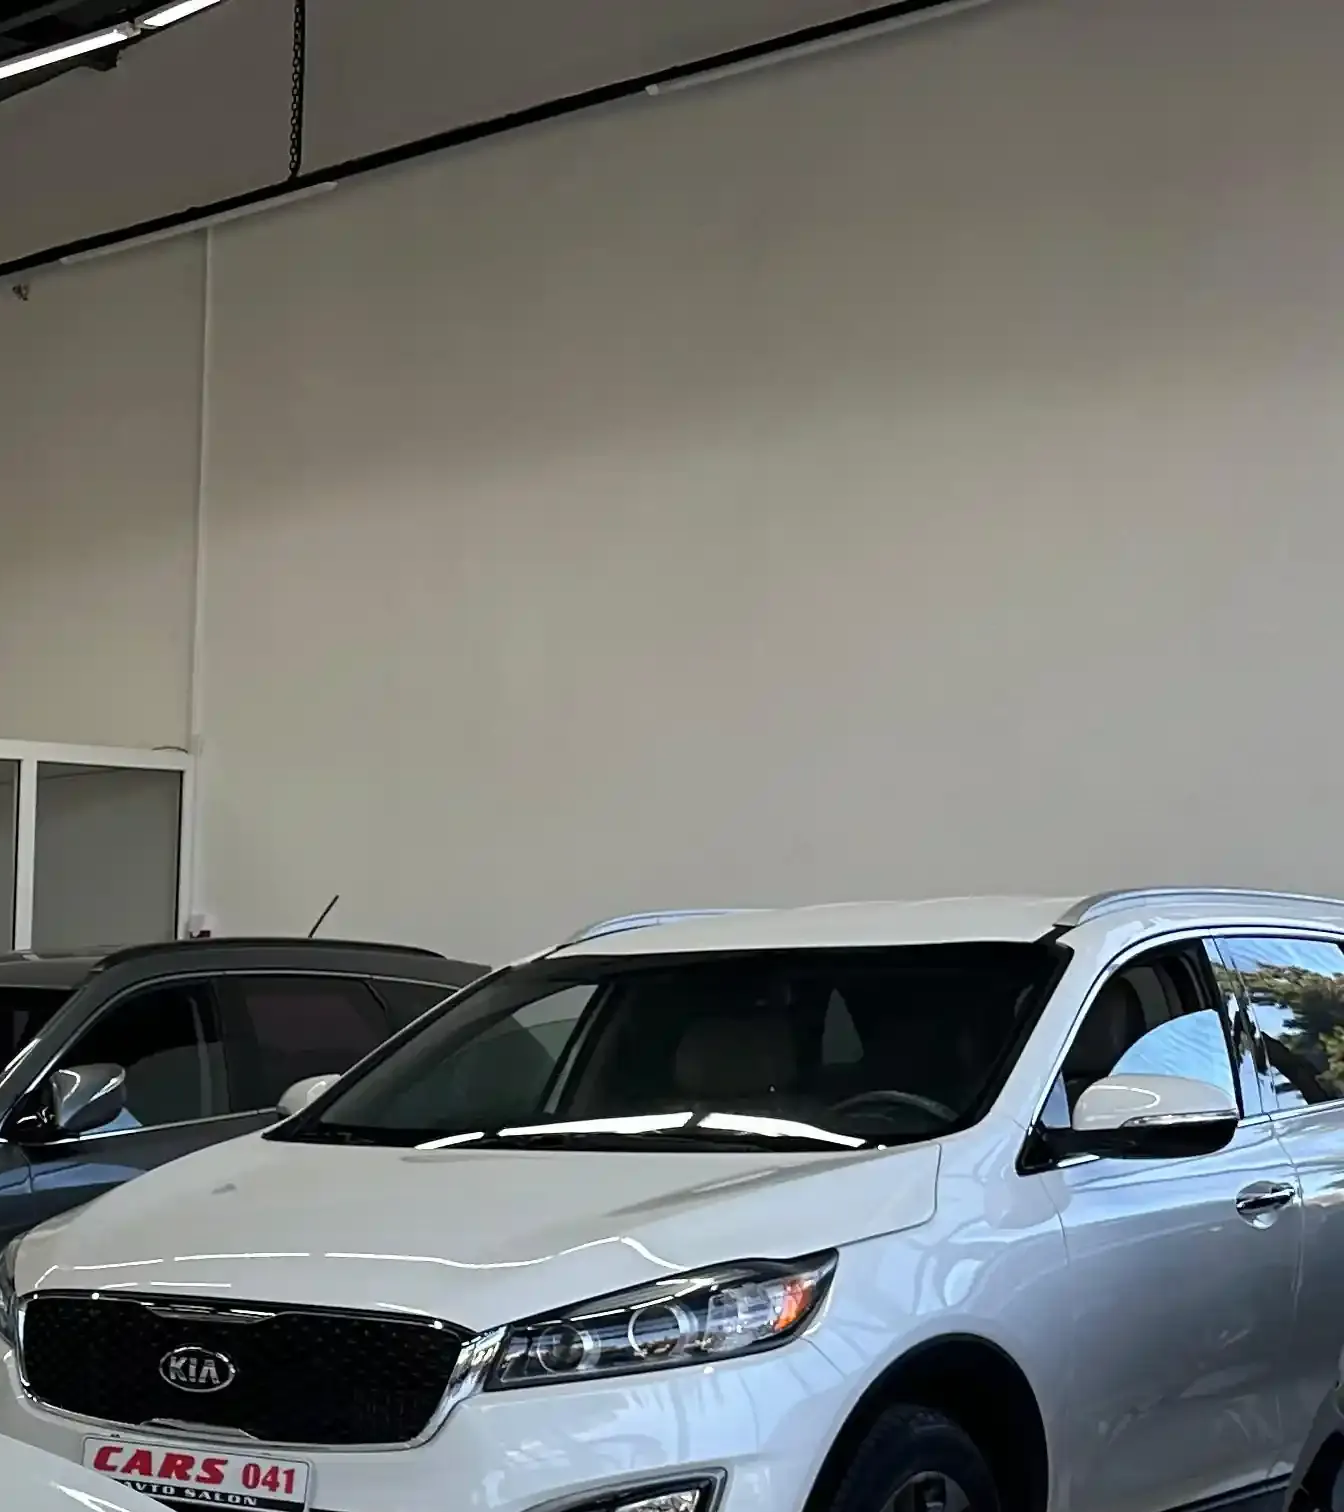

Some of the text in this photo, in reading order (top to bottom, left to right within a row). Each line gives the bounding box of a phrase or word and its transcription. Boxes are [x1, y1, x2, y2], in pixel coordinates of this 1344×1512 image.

[170, 1356, 220, 1386] KIA
[93, 1446, 296, 1494] CARS 041
[185, 1488, 258, 1507] SALON
